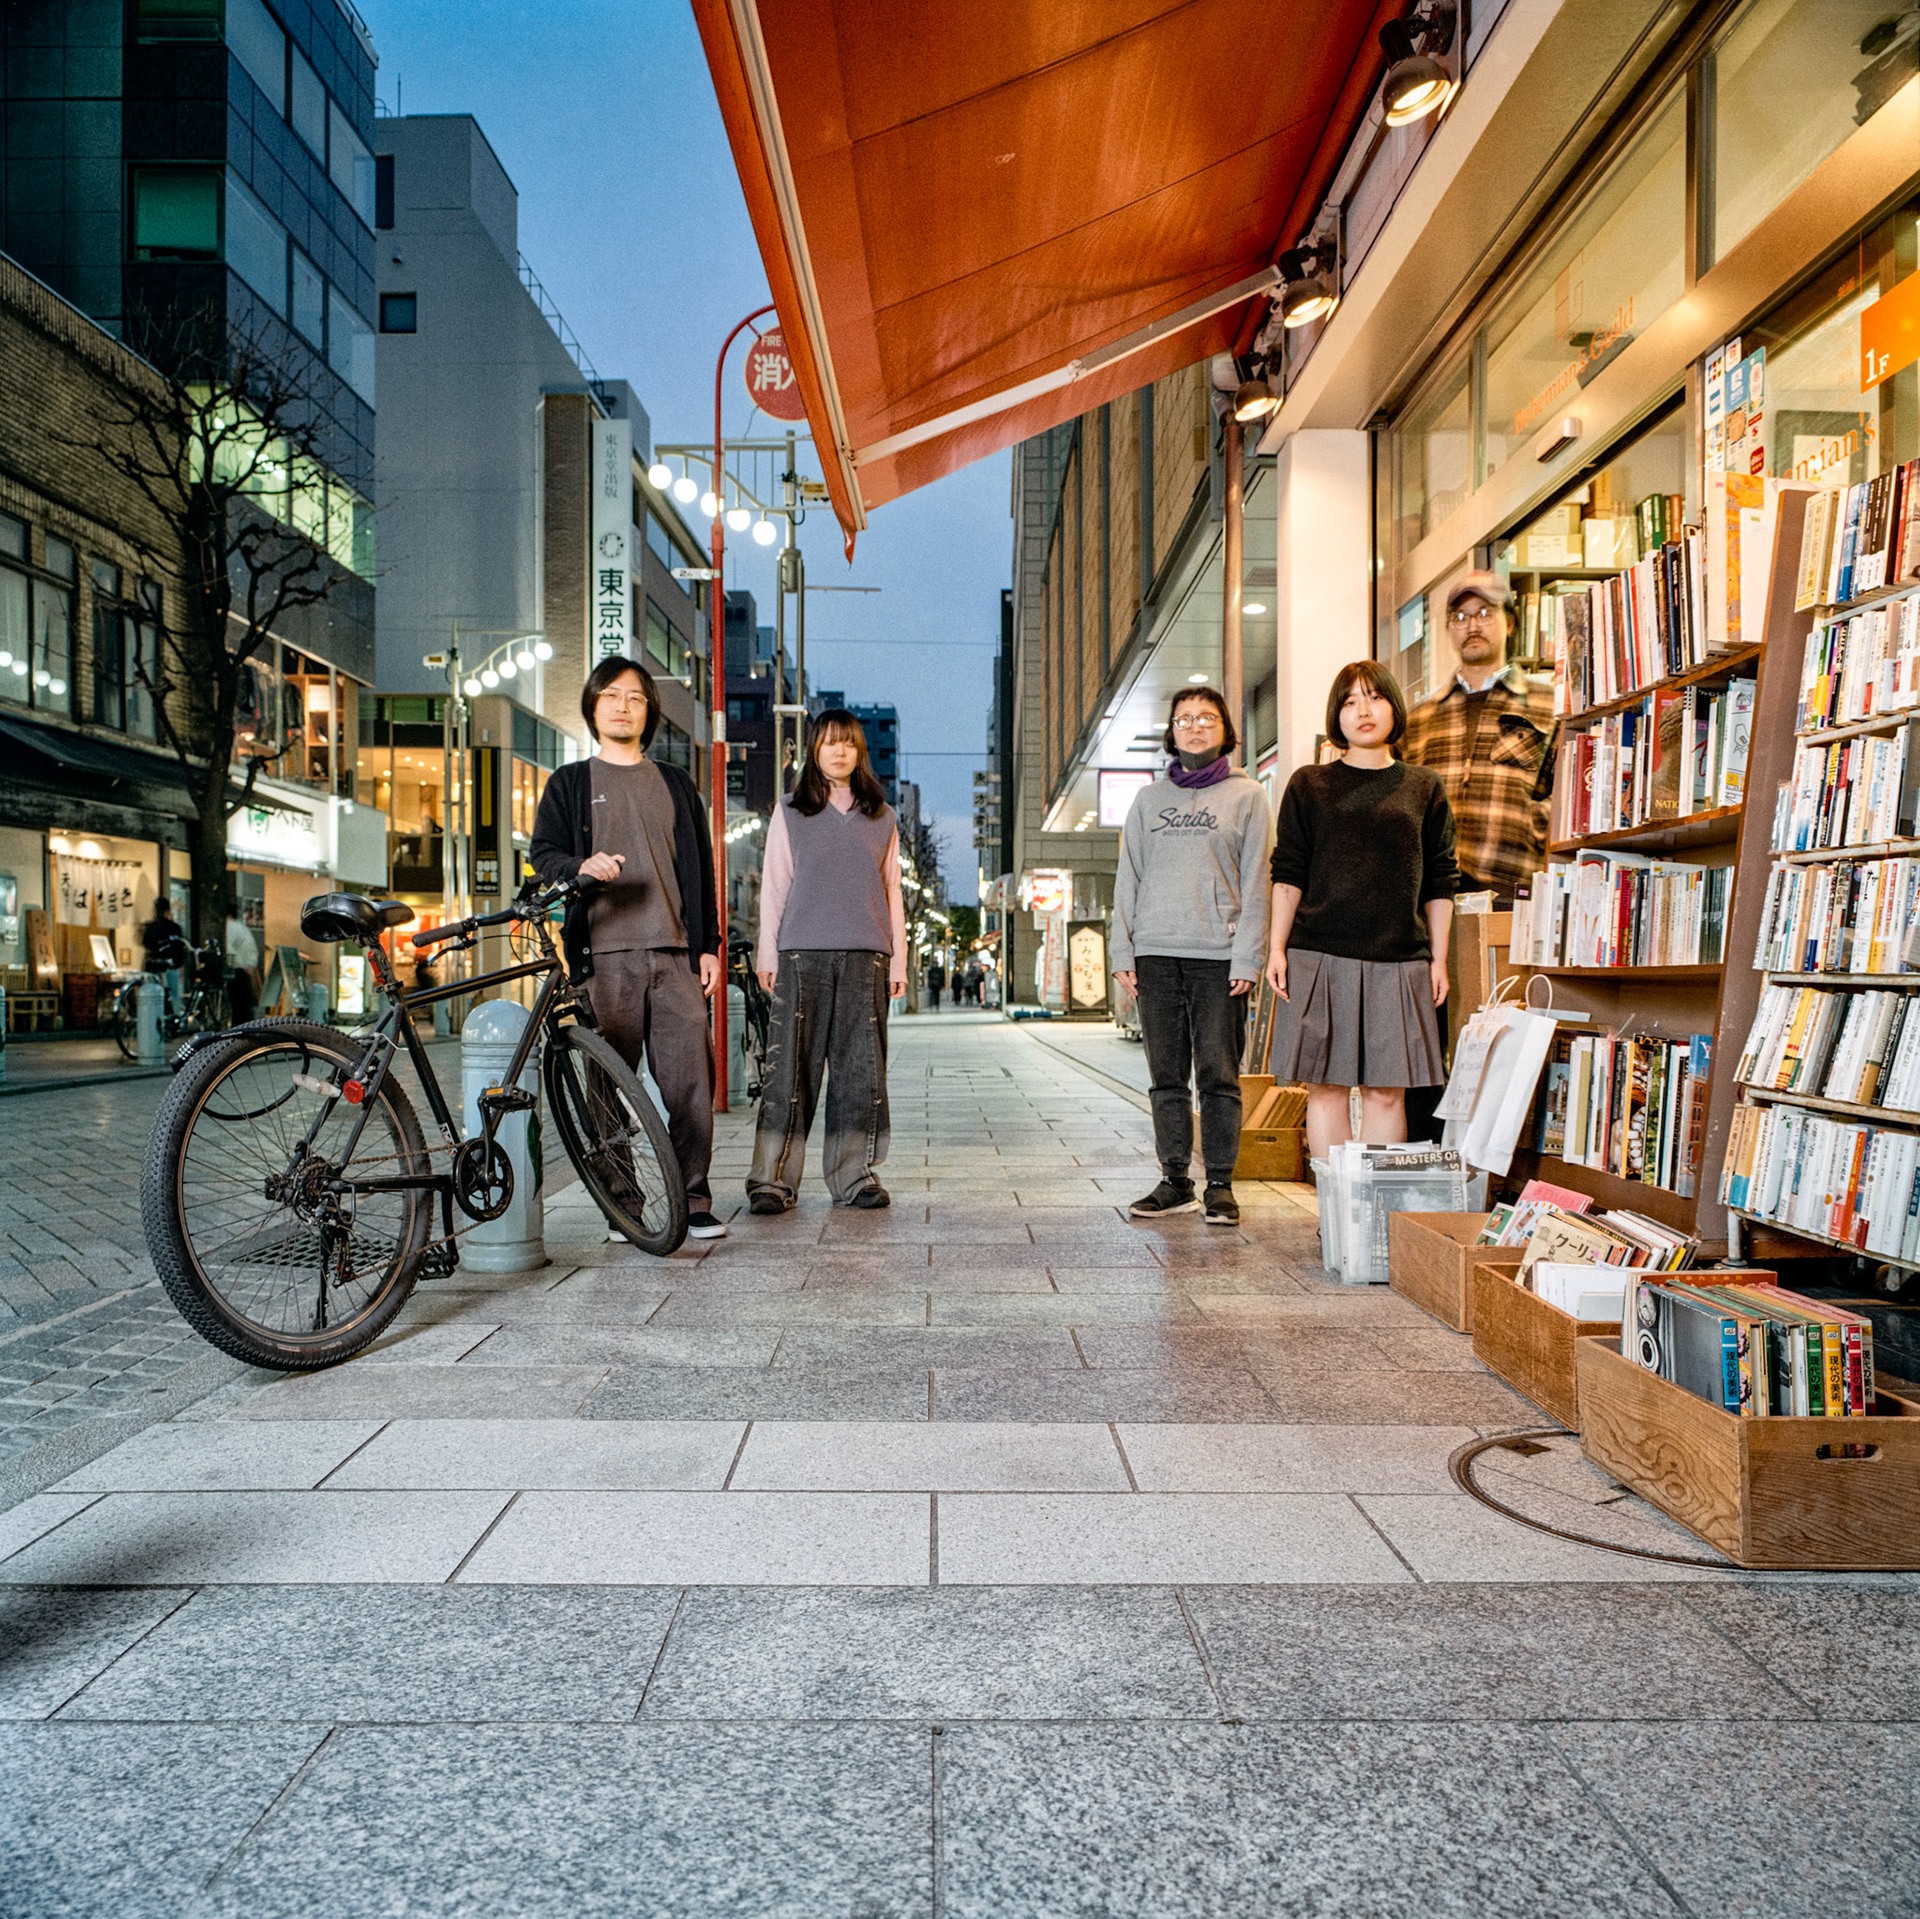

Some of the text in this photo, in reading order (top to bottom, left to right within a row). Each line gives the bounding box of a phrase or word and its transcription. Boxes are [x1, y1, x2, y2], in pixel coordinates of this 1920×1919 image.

[761, 335, 782, 347] FIRE
[1590, 296, 1634, 360] Guild
[1865, 348, 1890, 384] 1F
[604, 433, 618, 498] 東京堂出版
[1767, 411, 1876, 481] emian's
[598, 567, 624, 657] 東京堂
[1395, 1151, 1458, 1166] MASTERS OF
[1726, 1351, 1737, 1397] 現代の美術
[1811, 1356, 1821, 1402] 現代の美術
[1829, 1356, 1841, 1402] 現代の美術
[1852, 1357, 1863, 1402] 現代の美術
[1863, 1350, 1873, 1398] 現代の美術
